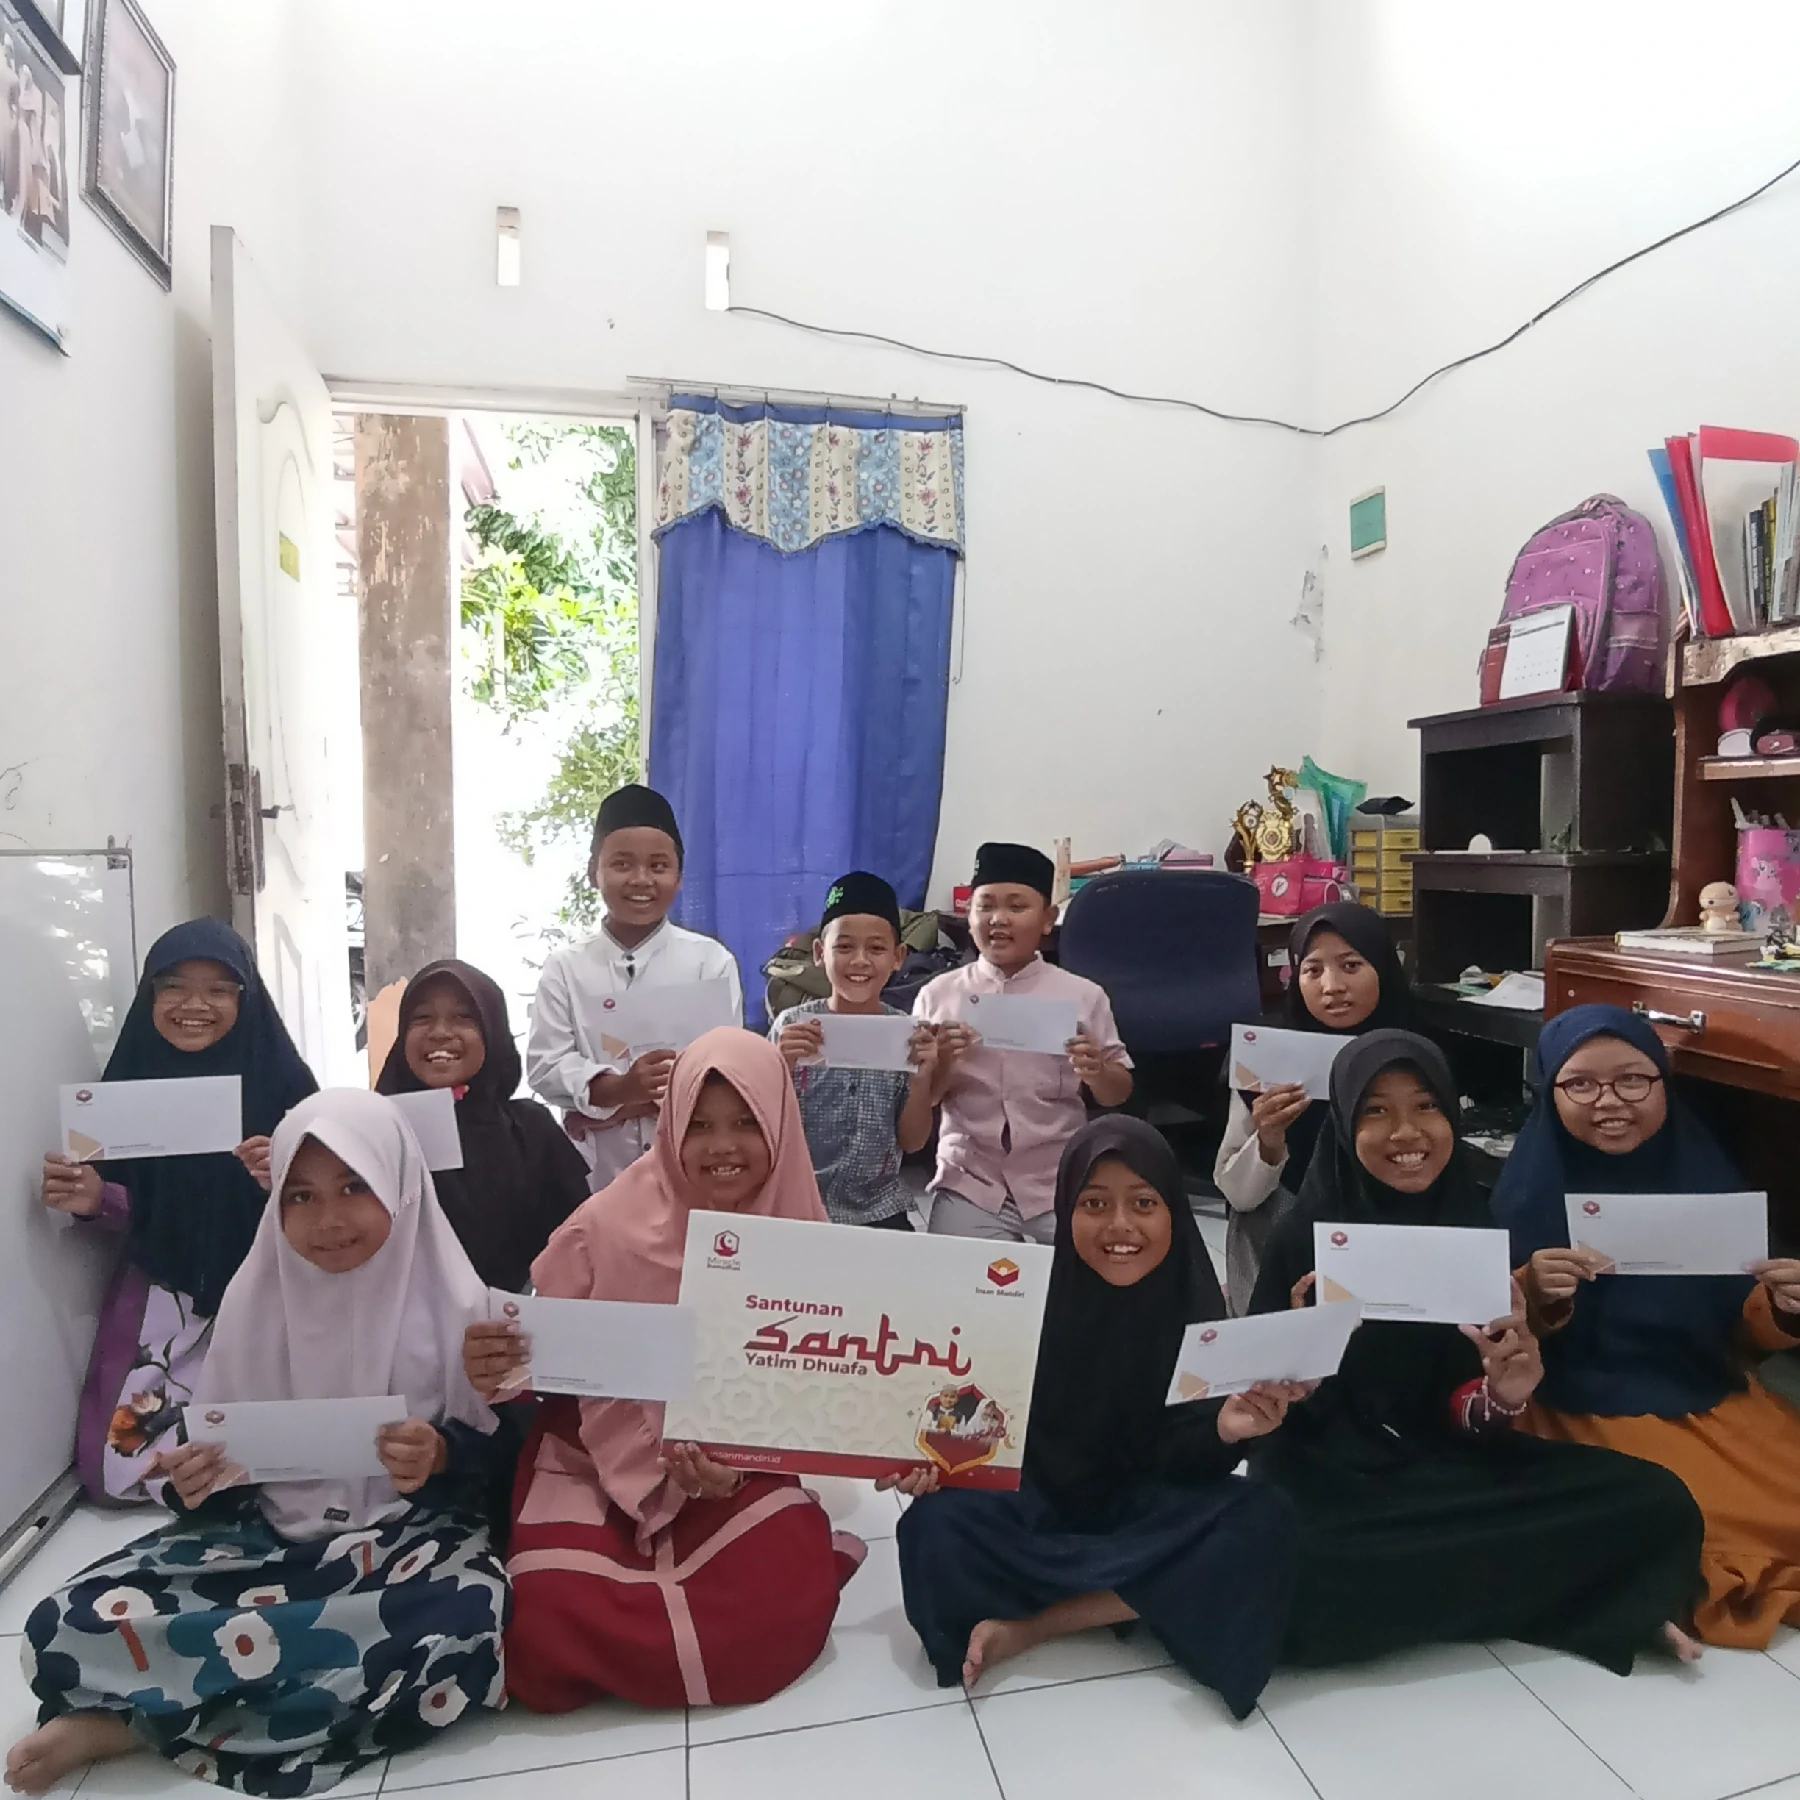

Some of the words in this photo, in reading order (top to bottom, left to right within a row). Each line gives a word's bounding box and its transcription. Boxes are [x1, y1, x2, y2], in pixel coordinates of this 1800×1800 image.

[975, 1287, 994, 1295] Insan
[996, 1289, 1025, 1298] Mandiri
[745, 1294, 843, 1318] Santunan
[743, 1313, 972, 1377] Santri
[745, 1352, 797, 1370] Yatim
[802, 1357, 868, 1376] Dhuafa
